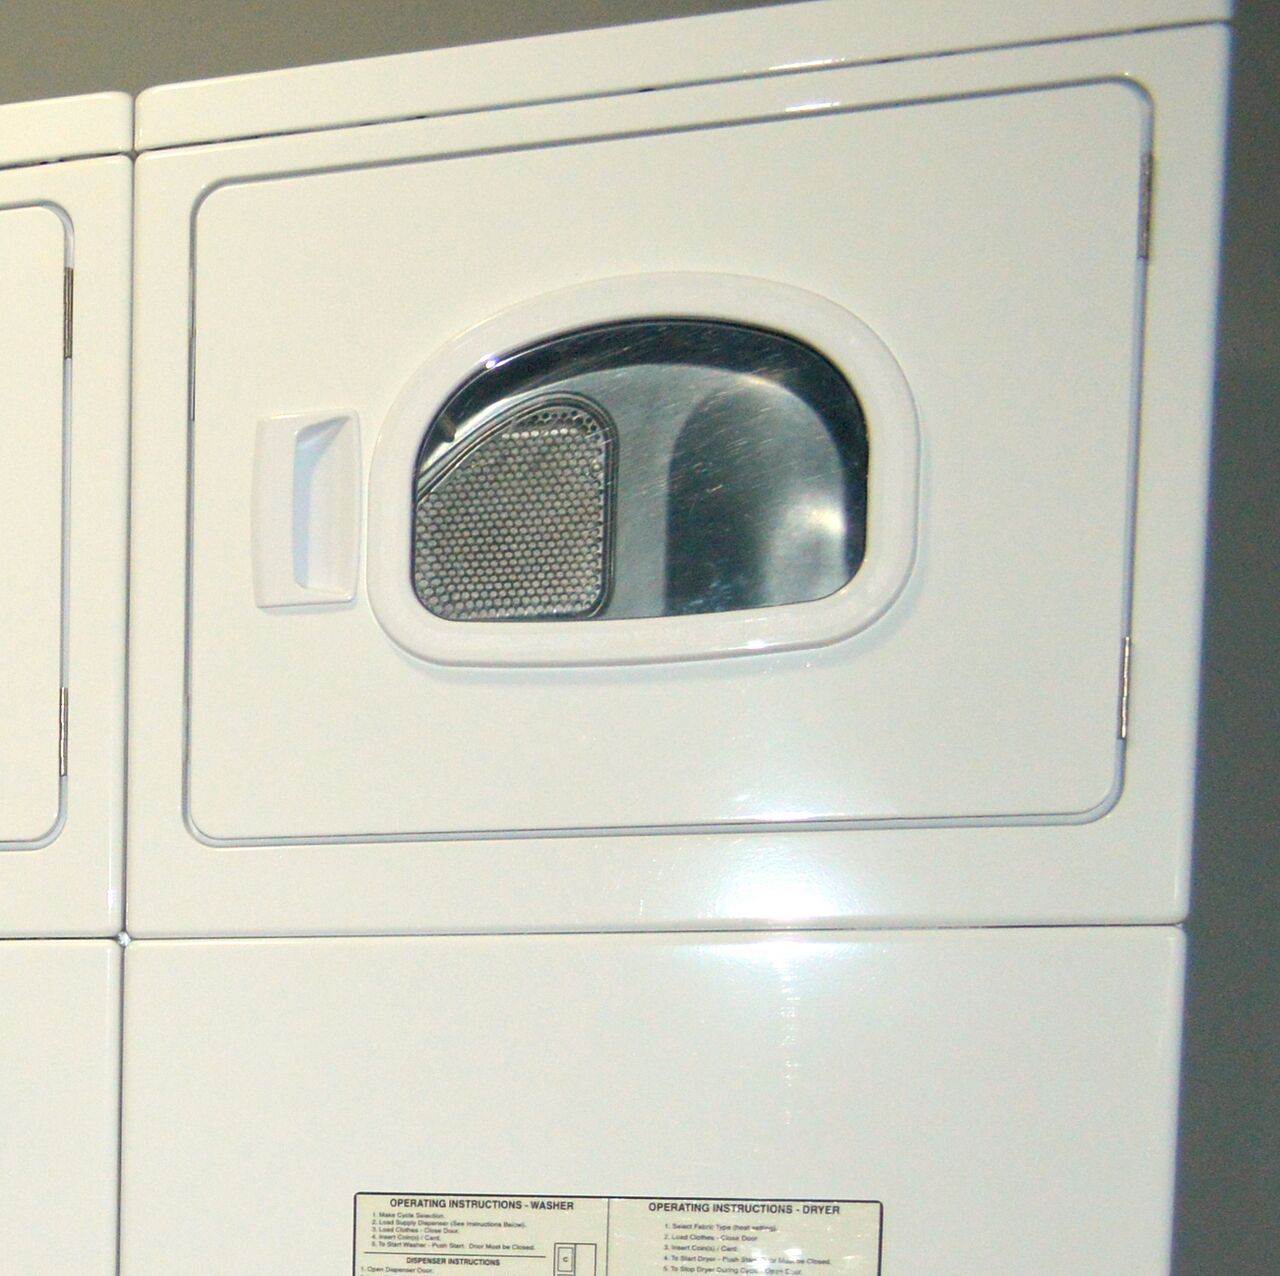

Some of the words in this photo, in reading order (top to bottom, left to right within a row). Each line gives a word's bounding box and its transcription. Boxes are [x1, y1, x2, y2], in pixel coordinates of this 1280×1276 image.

[390, 1199, 446, 1208] OPERATING
[449, 1199, 522, 1210] INSTRUCTIONS
[530, 1201, 574, 1210] WASHER
[648, 1202, 710, 1213] OPERATING
[713, 1204, 793, 1214] INSTRUCTIONS
[802, 1205, 840, 1215] DRYER
[406, 1257, 446, 1265] DISPENSER
[448, 1258, 500, 1266] INSTRUCTIONS
